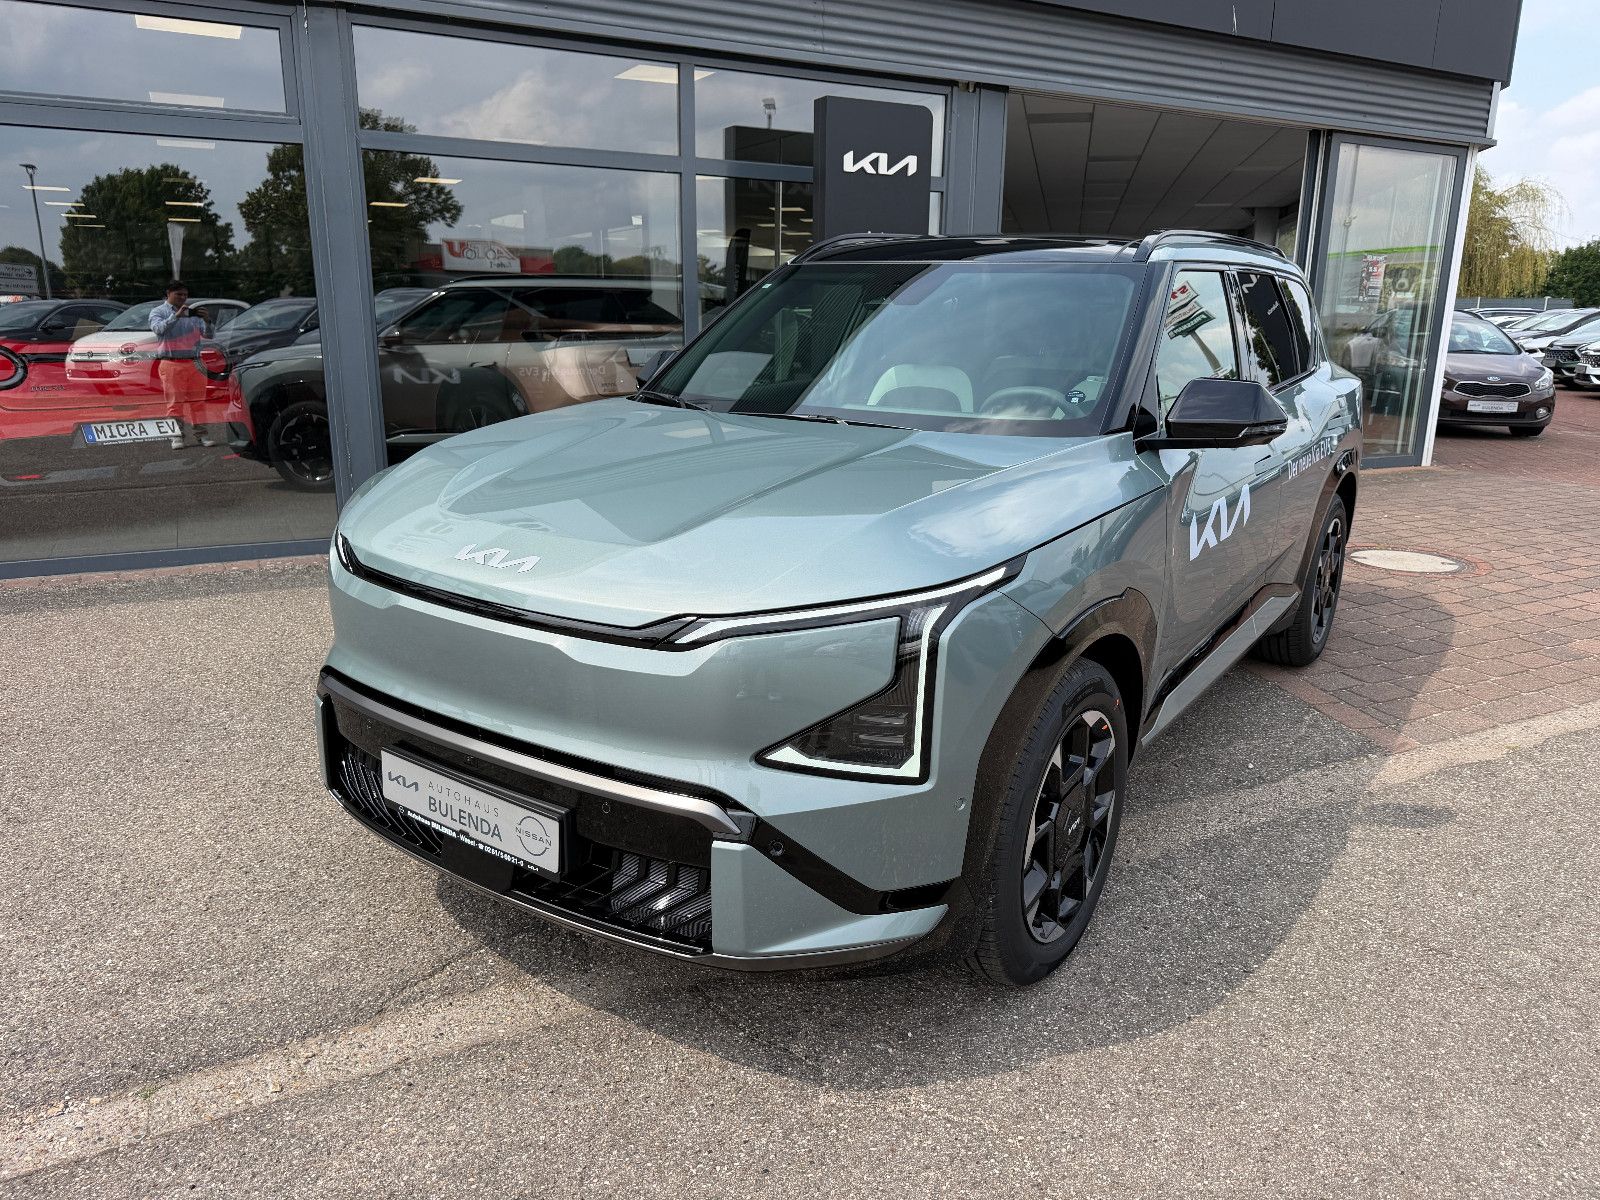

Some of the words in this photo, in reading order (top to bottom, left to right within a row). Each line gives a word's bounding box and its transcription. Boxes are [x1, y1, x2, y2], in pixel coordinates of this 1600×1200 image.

[843, 150, 918, 176] KIA
[93, 421, 149, 440] MICRA
[155, 419, 176, 436] EV
[1287, 459, 1299, 480] Der
[1298, 453, 1312, 473] neue
[1320, 437, 1331, 460] EV5
[1189, 483, 1251, 562] KIA
[454, 543, 542, 574] KIA
[387, 770, 419, 793] KIA
[428, 781, 499, 818] AUTOHAUS
[428, 795, 503, 843] BULENDA
[515, 826, 552, 847] NISSAN
